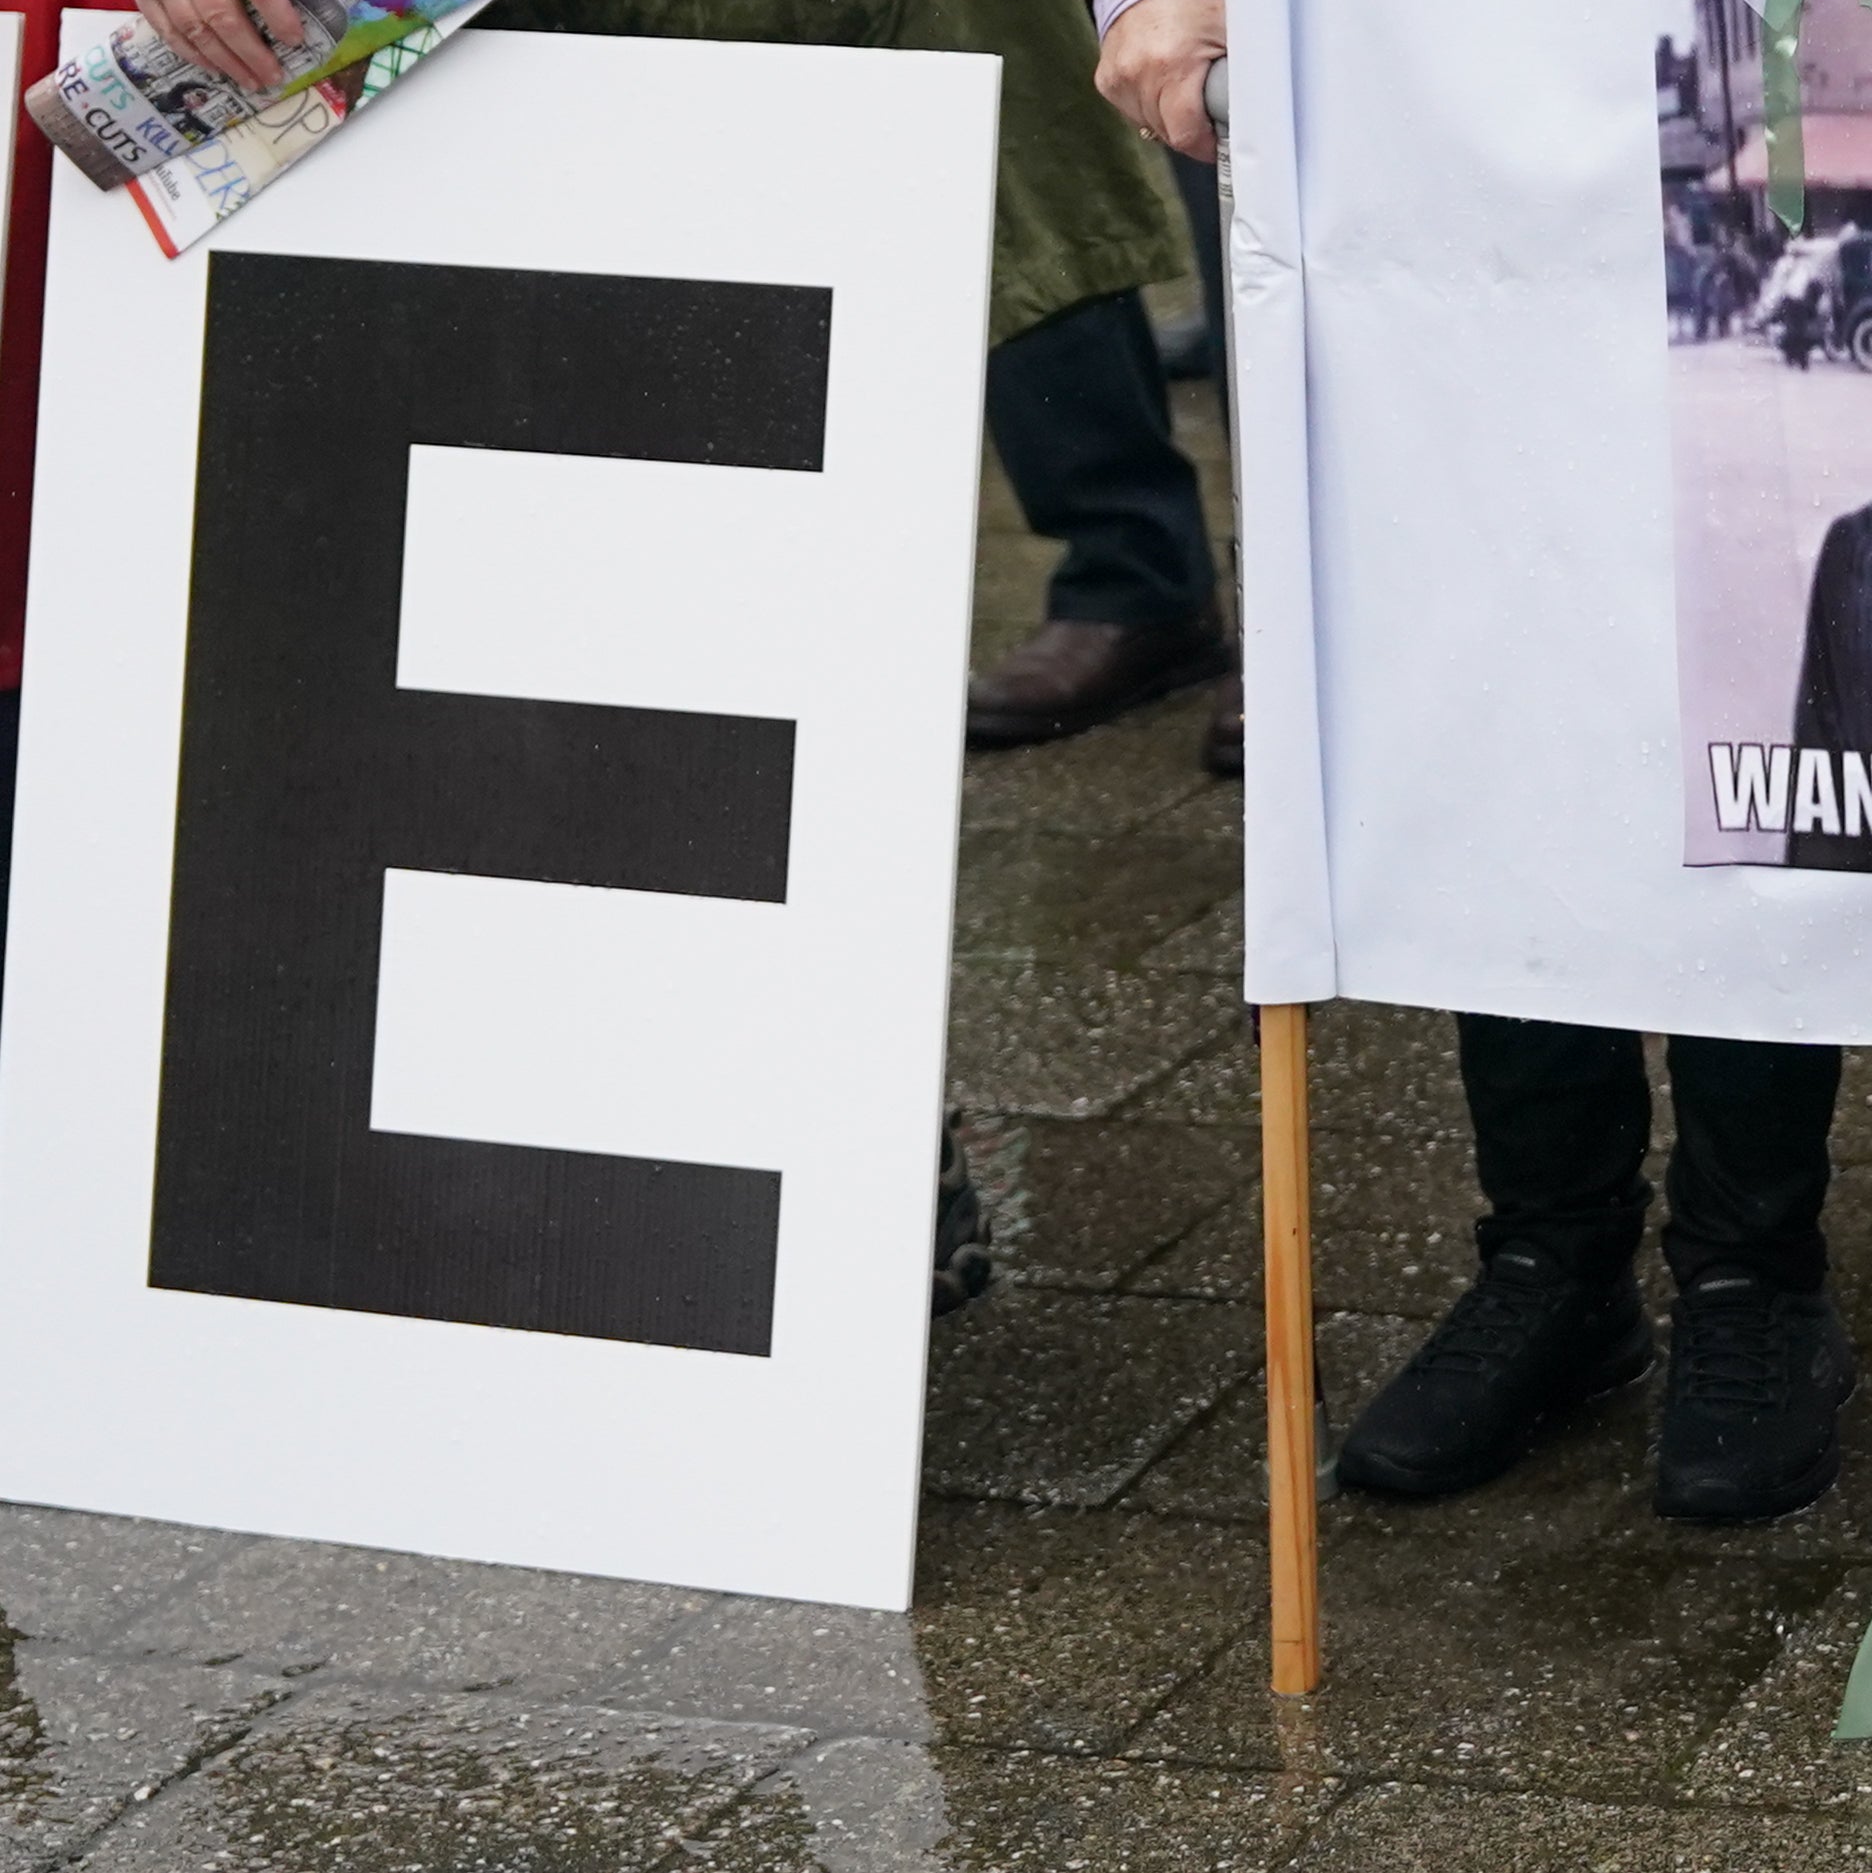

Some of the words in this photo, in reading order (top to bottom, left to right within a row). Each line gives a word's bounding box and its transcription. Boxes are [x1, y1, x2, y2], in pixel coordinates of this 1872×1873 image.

[84, 42, 136, 112] CUTS
[136, 115, 183, 159] KILL
[85, 106, 149, 166] CUTS
[152, 162, 181, 202] uTube
[148, 247, 834, 1358] E
